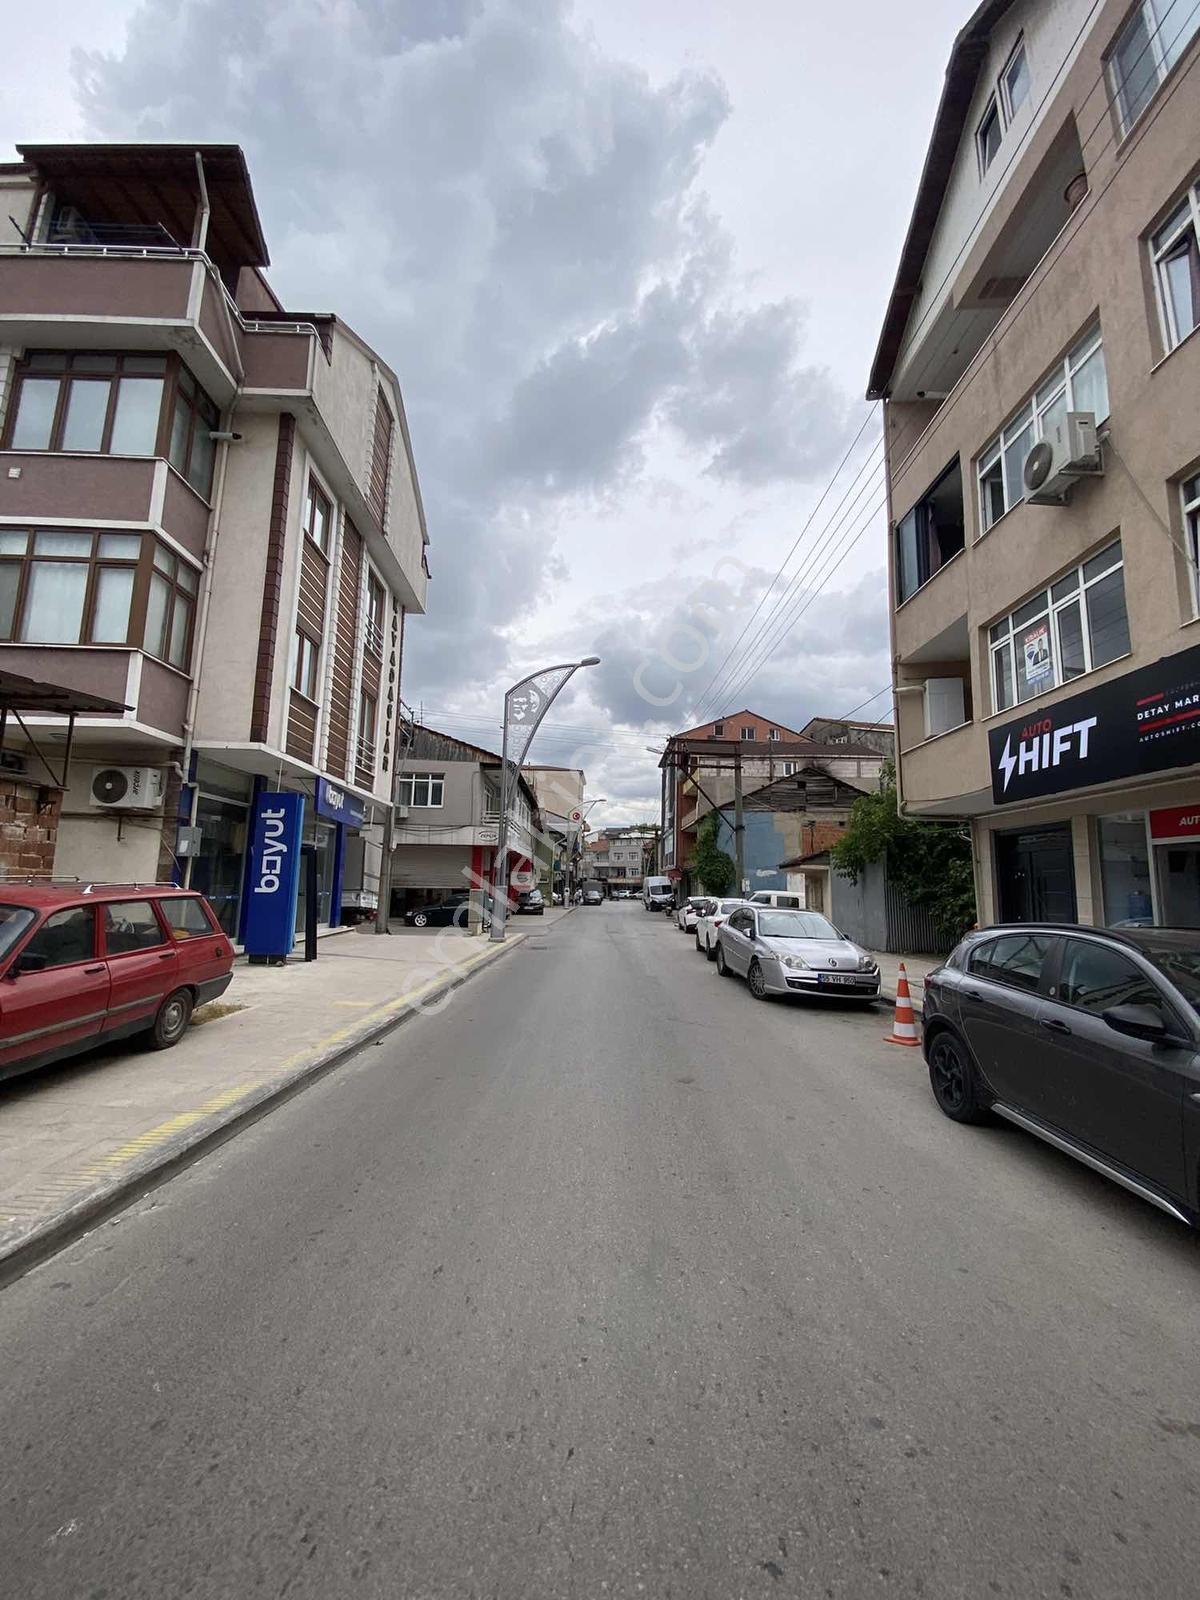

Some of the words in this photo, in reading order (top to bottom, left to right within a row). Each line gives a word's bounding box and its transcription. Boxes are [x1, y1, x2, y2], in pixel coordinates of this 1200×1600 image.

[1137, 704, 1169, 720] DETAY
[1175, 694, 1200, 708] MAR
[1021, 718, 1052, 738] AUTO
